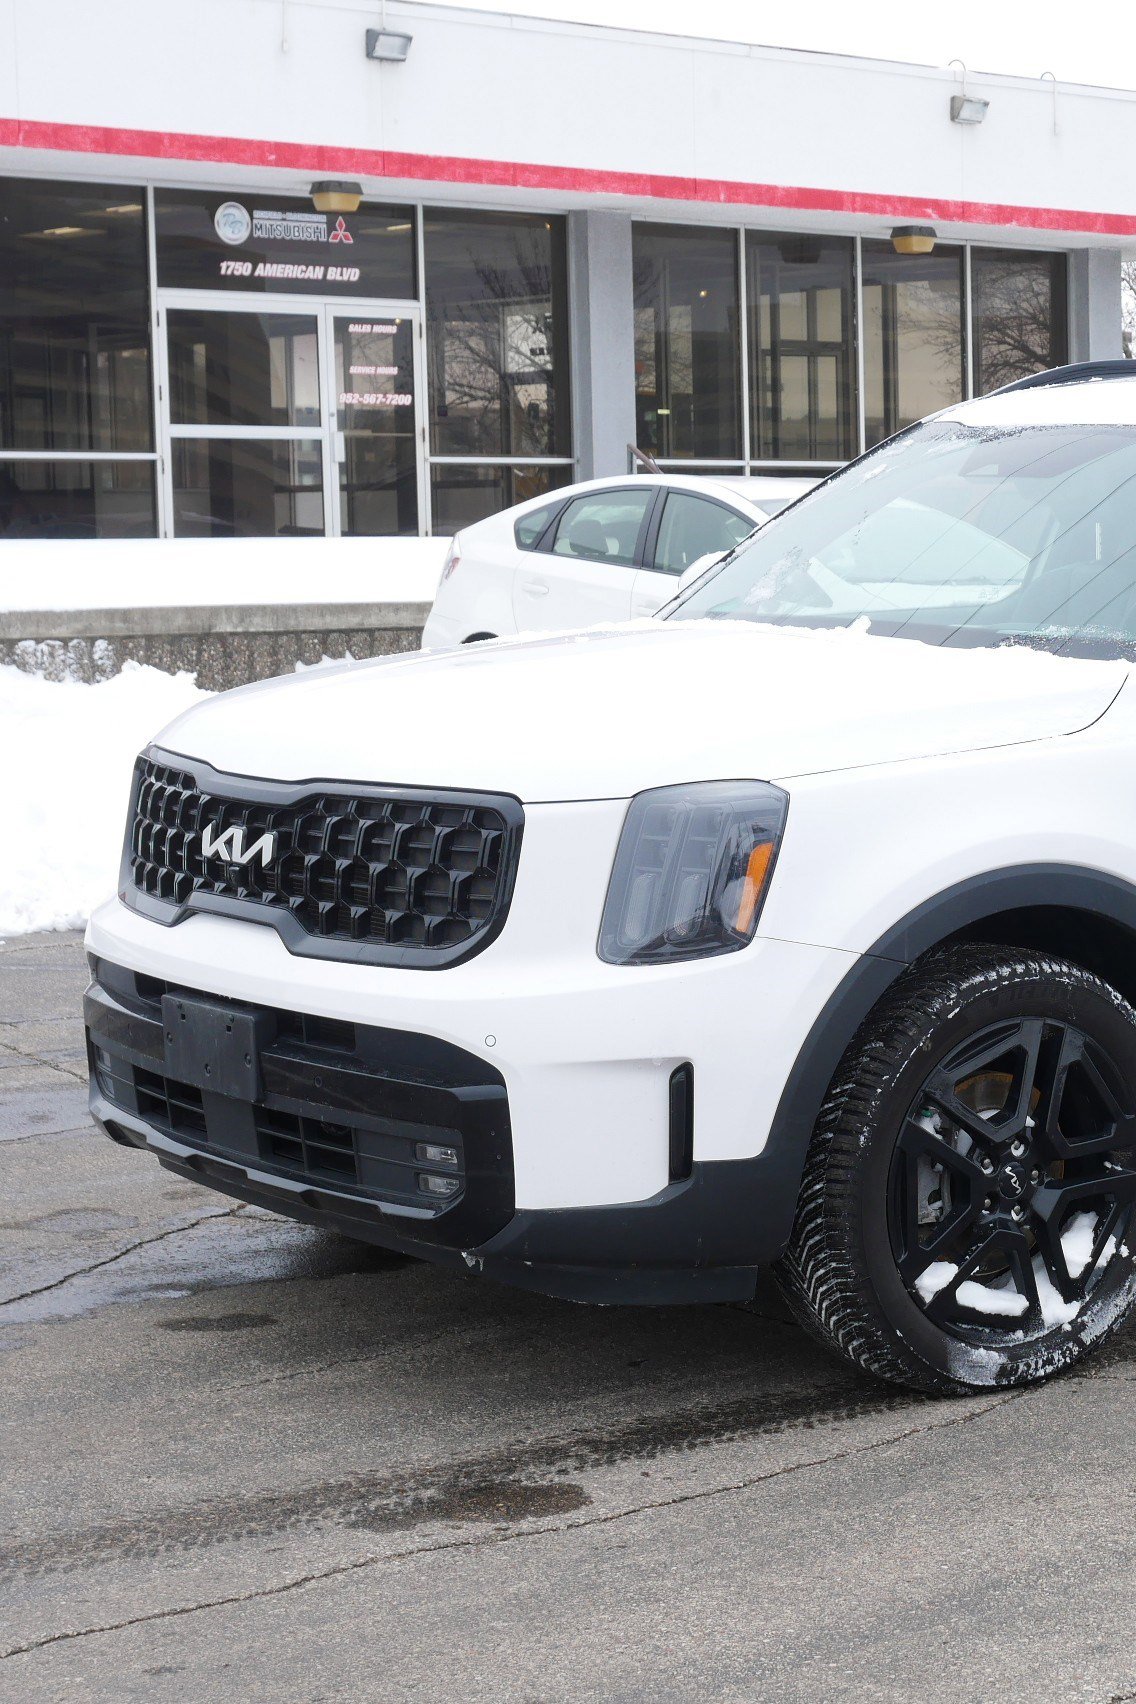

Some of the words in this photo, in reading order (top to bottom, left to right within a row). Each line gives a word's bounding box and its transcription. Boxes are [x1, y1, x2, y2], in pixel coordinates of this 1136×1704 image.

[253, 222, 328, 241] MITSUBISHI
[220, 261, 252, 276] 1750
[254, 263, 324, 279] AMERICAN
[326, 267, 360, 281] BLVD
[349, 324, 371, 332] SALES
[372, 325, 397, 333] HOURS
[349, 366, 376, 374] SERVICE
[376, 367, 398, 375] HOURS
[339, 392, 412, 405] 952-567-7200
[201, 820, 278, 868] KIA
